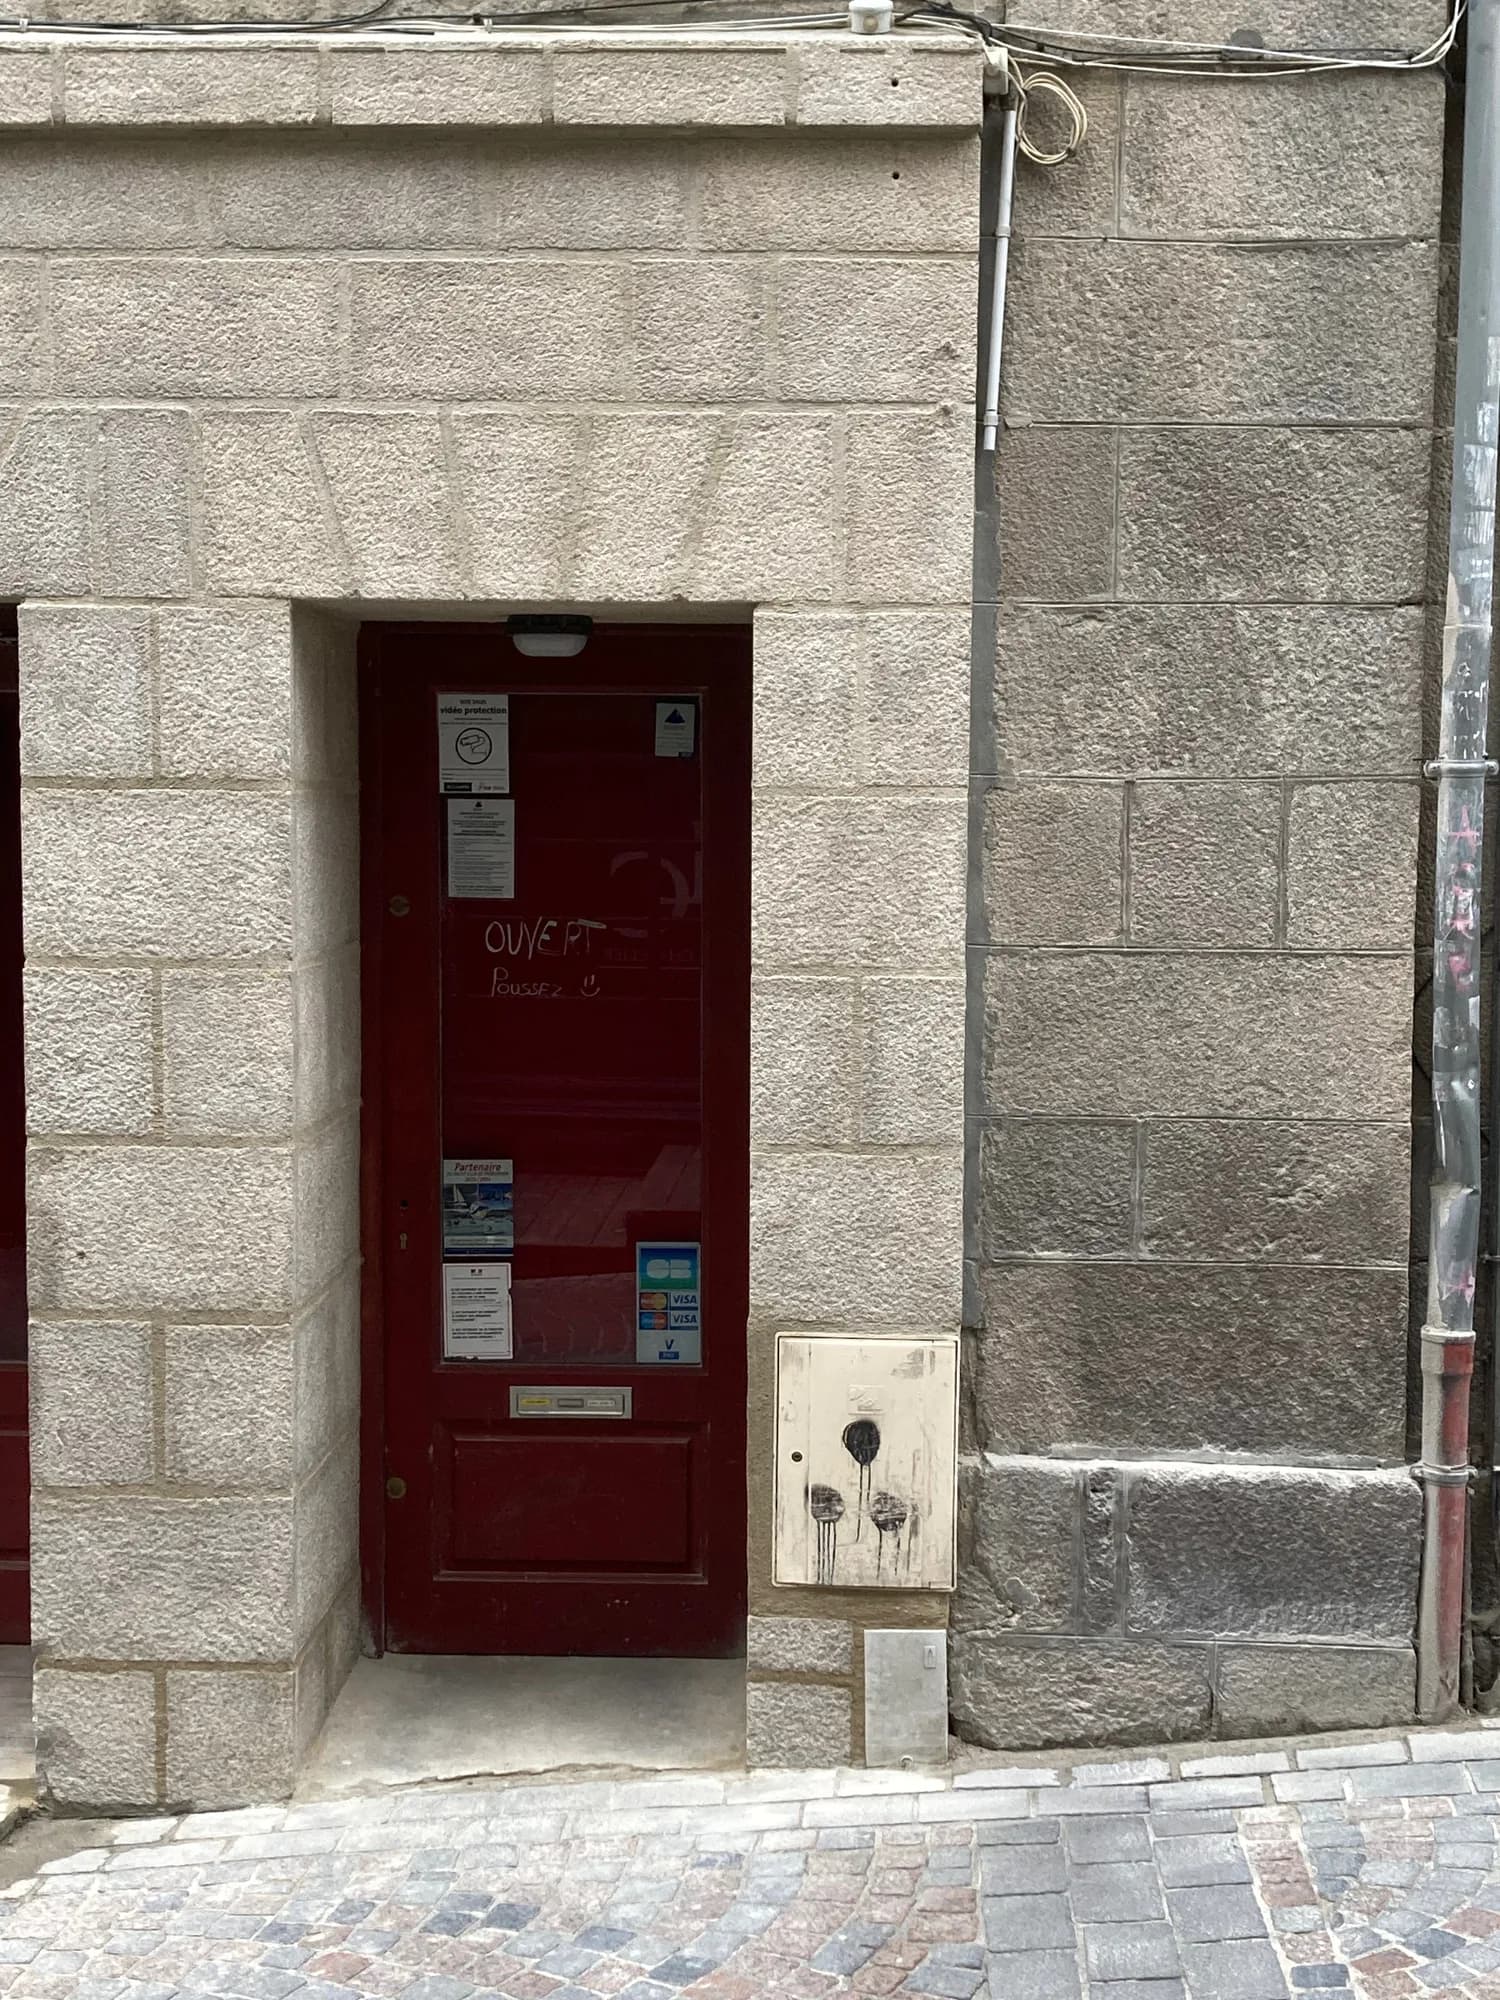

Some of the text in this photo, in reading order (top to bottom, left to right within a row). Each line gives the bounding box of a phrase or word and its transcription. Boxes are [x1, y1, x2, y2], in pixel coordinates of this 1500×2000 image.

[440, 706, 507, 716] vidéo protection
[485, 916, 607, 960] OUVERT
[454, 1162, 502, 1171] Partenaire
[646, 1259, 691, 1279] CB
[673, 1295, 697, 1304] VISA
[673, 1314, 697, 1323] VISA
